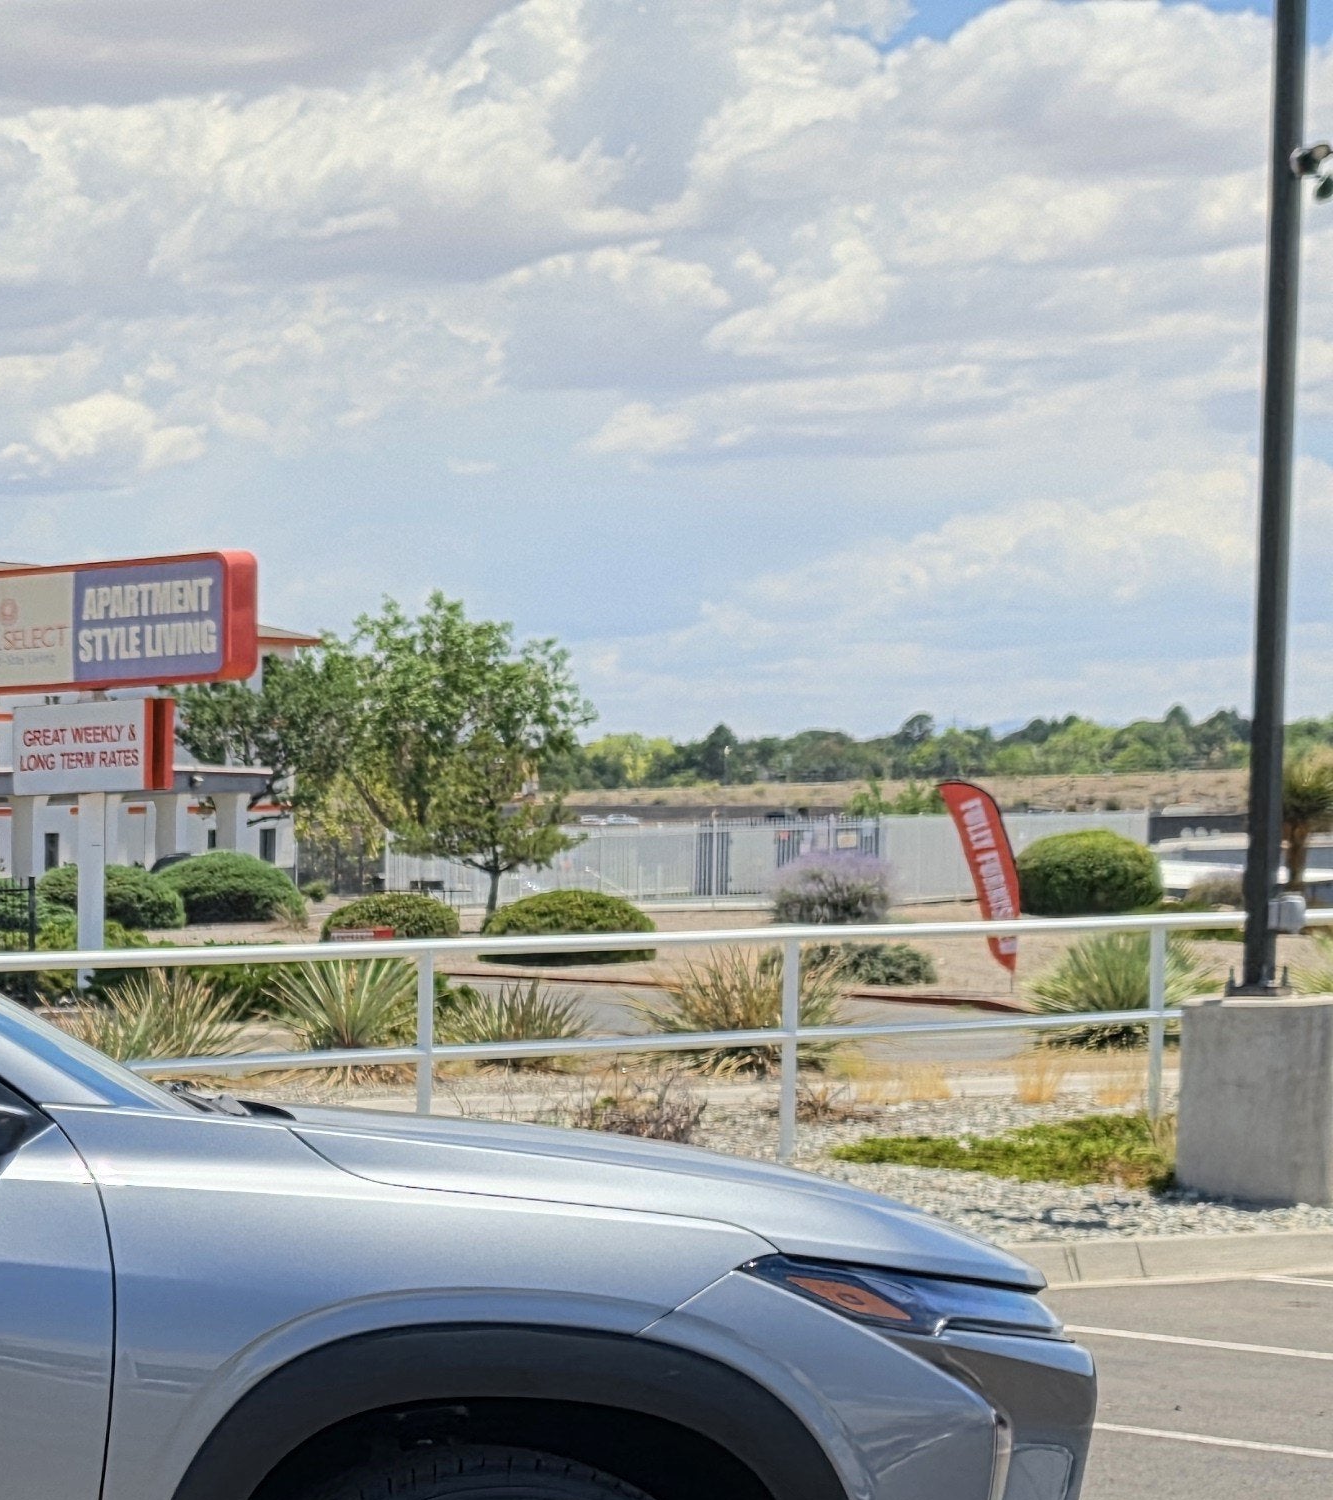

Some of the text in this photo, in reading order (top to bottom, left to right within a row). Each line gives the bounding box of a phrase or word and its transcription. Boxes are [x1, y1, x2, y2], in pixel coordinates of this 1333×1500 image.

[82, 577, 214, 621] APARTMENT
[3, 625, 70, 651] SELECT
[78, 619, 218, 663] STYLE LIVING
[23, 723, 136, 748] GREAT WEEKLY &
[19, 748, 139, 772] LONG TERM RATES
